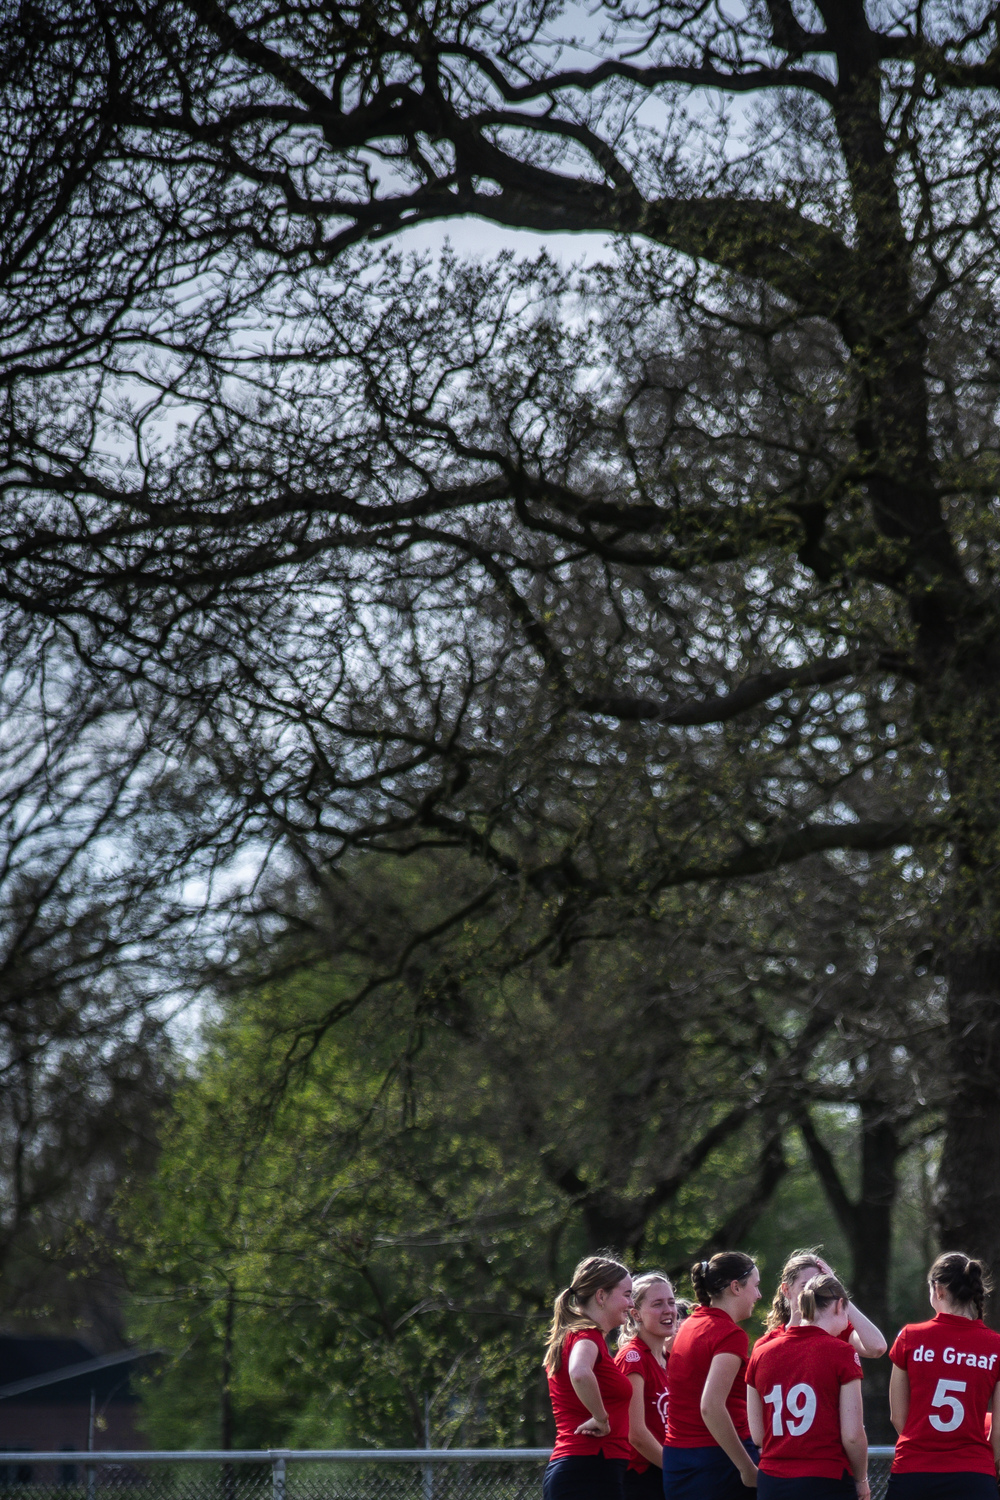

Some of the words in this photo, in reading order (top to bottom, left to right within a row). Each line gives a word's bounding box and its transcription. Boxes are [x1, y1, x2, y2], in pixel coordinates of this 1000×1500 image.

[912, 1344, 935, 1362] de
[942, 1347, 998, 1371] Graaf
[763, 1383, 817, 1437] 19
[928, 1378, 967, 1432] 5
